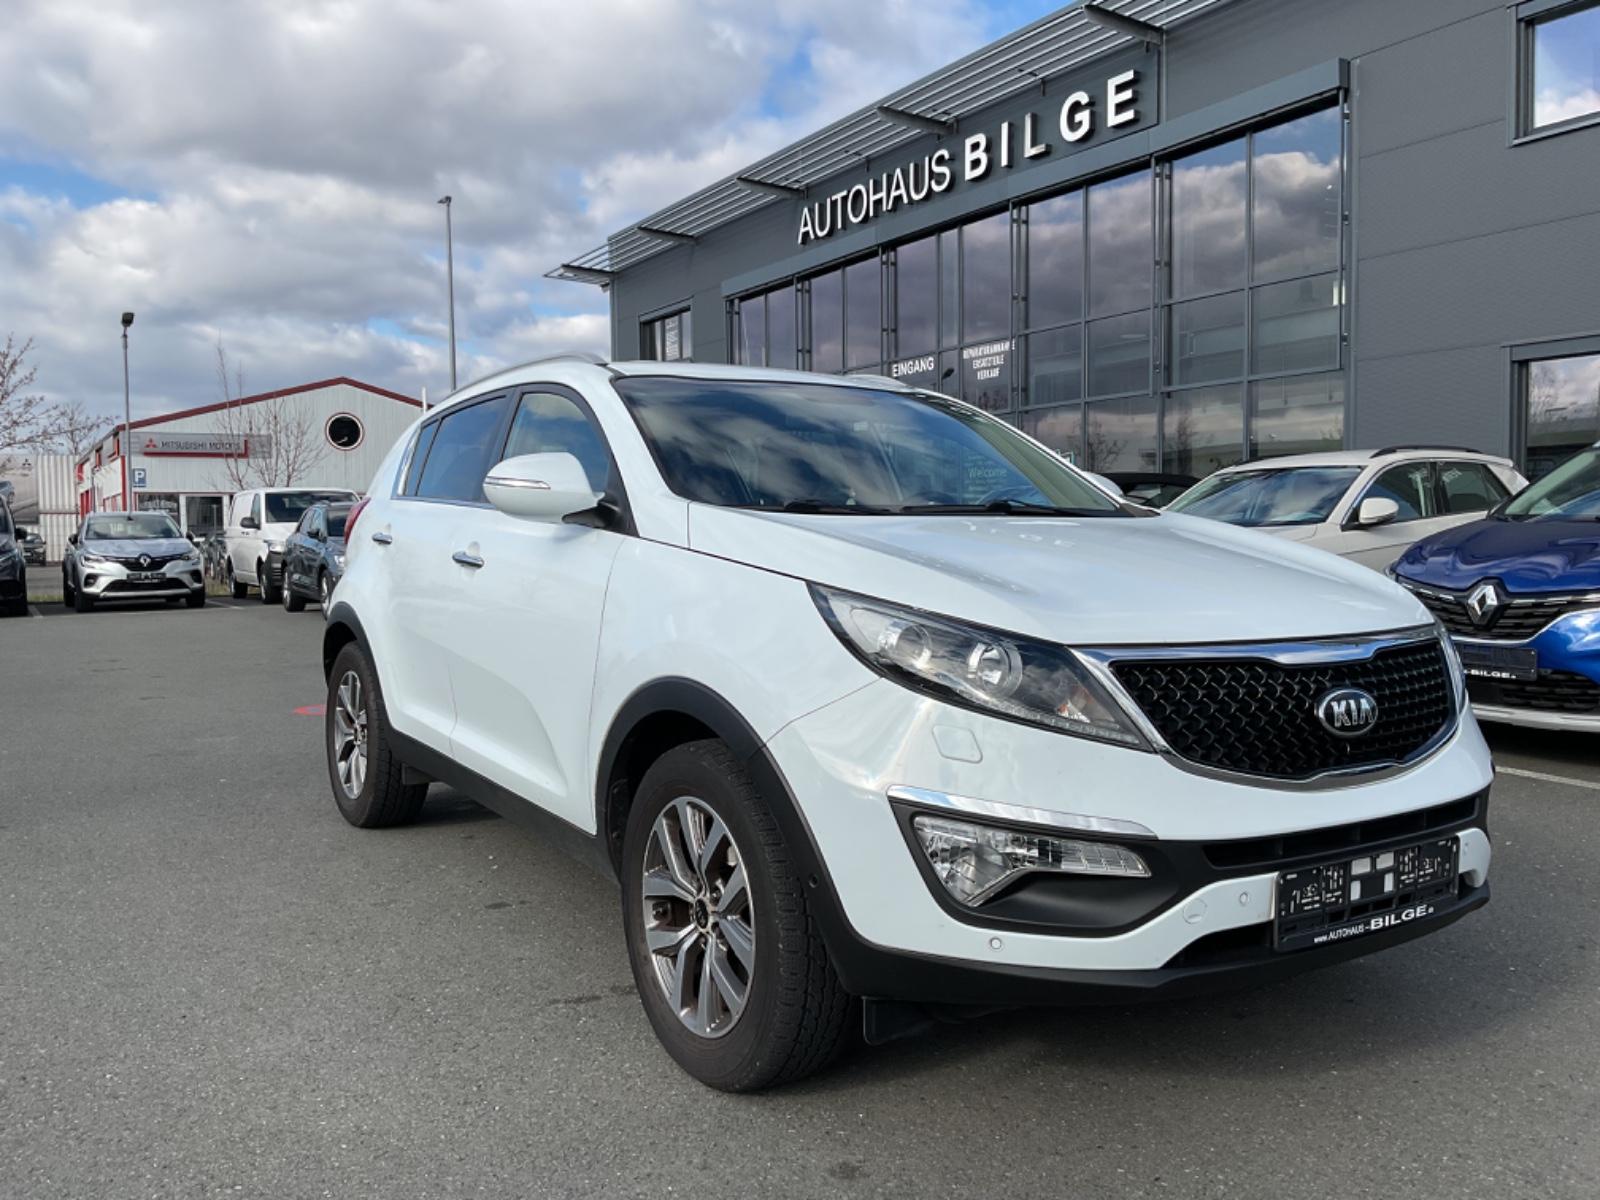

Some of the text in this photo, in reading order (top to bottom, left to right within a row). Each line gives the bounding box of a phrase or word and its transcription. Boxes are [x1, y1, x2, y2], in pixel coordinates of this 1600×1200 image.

[798, 69, 1136, 244] AUTOHAUS BILGE
[892, 356, 934, 377] EINGANG
[161, 440, 206, 450] MITSUBISHI
[135, 470, 144, 482] P
[1330, 697, 1374, 728] KIA
